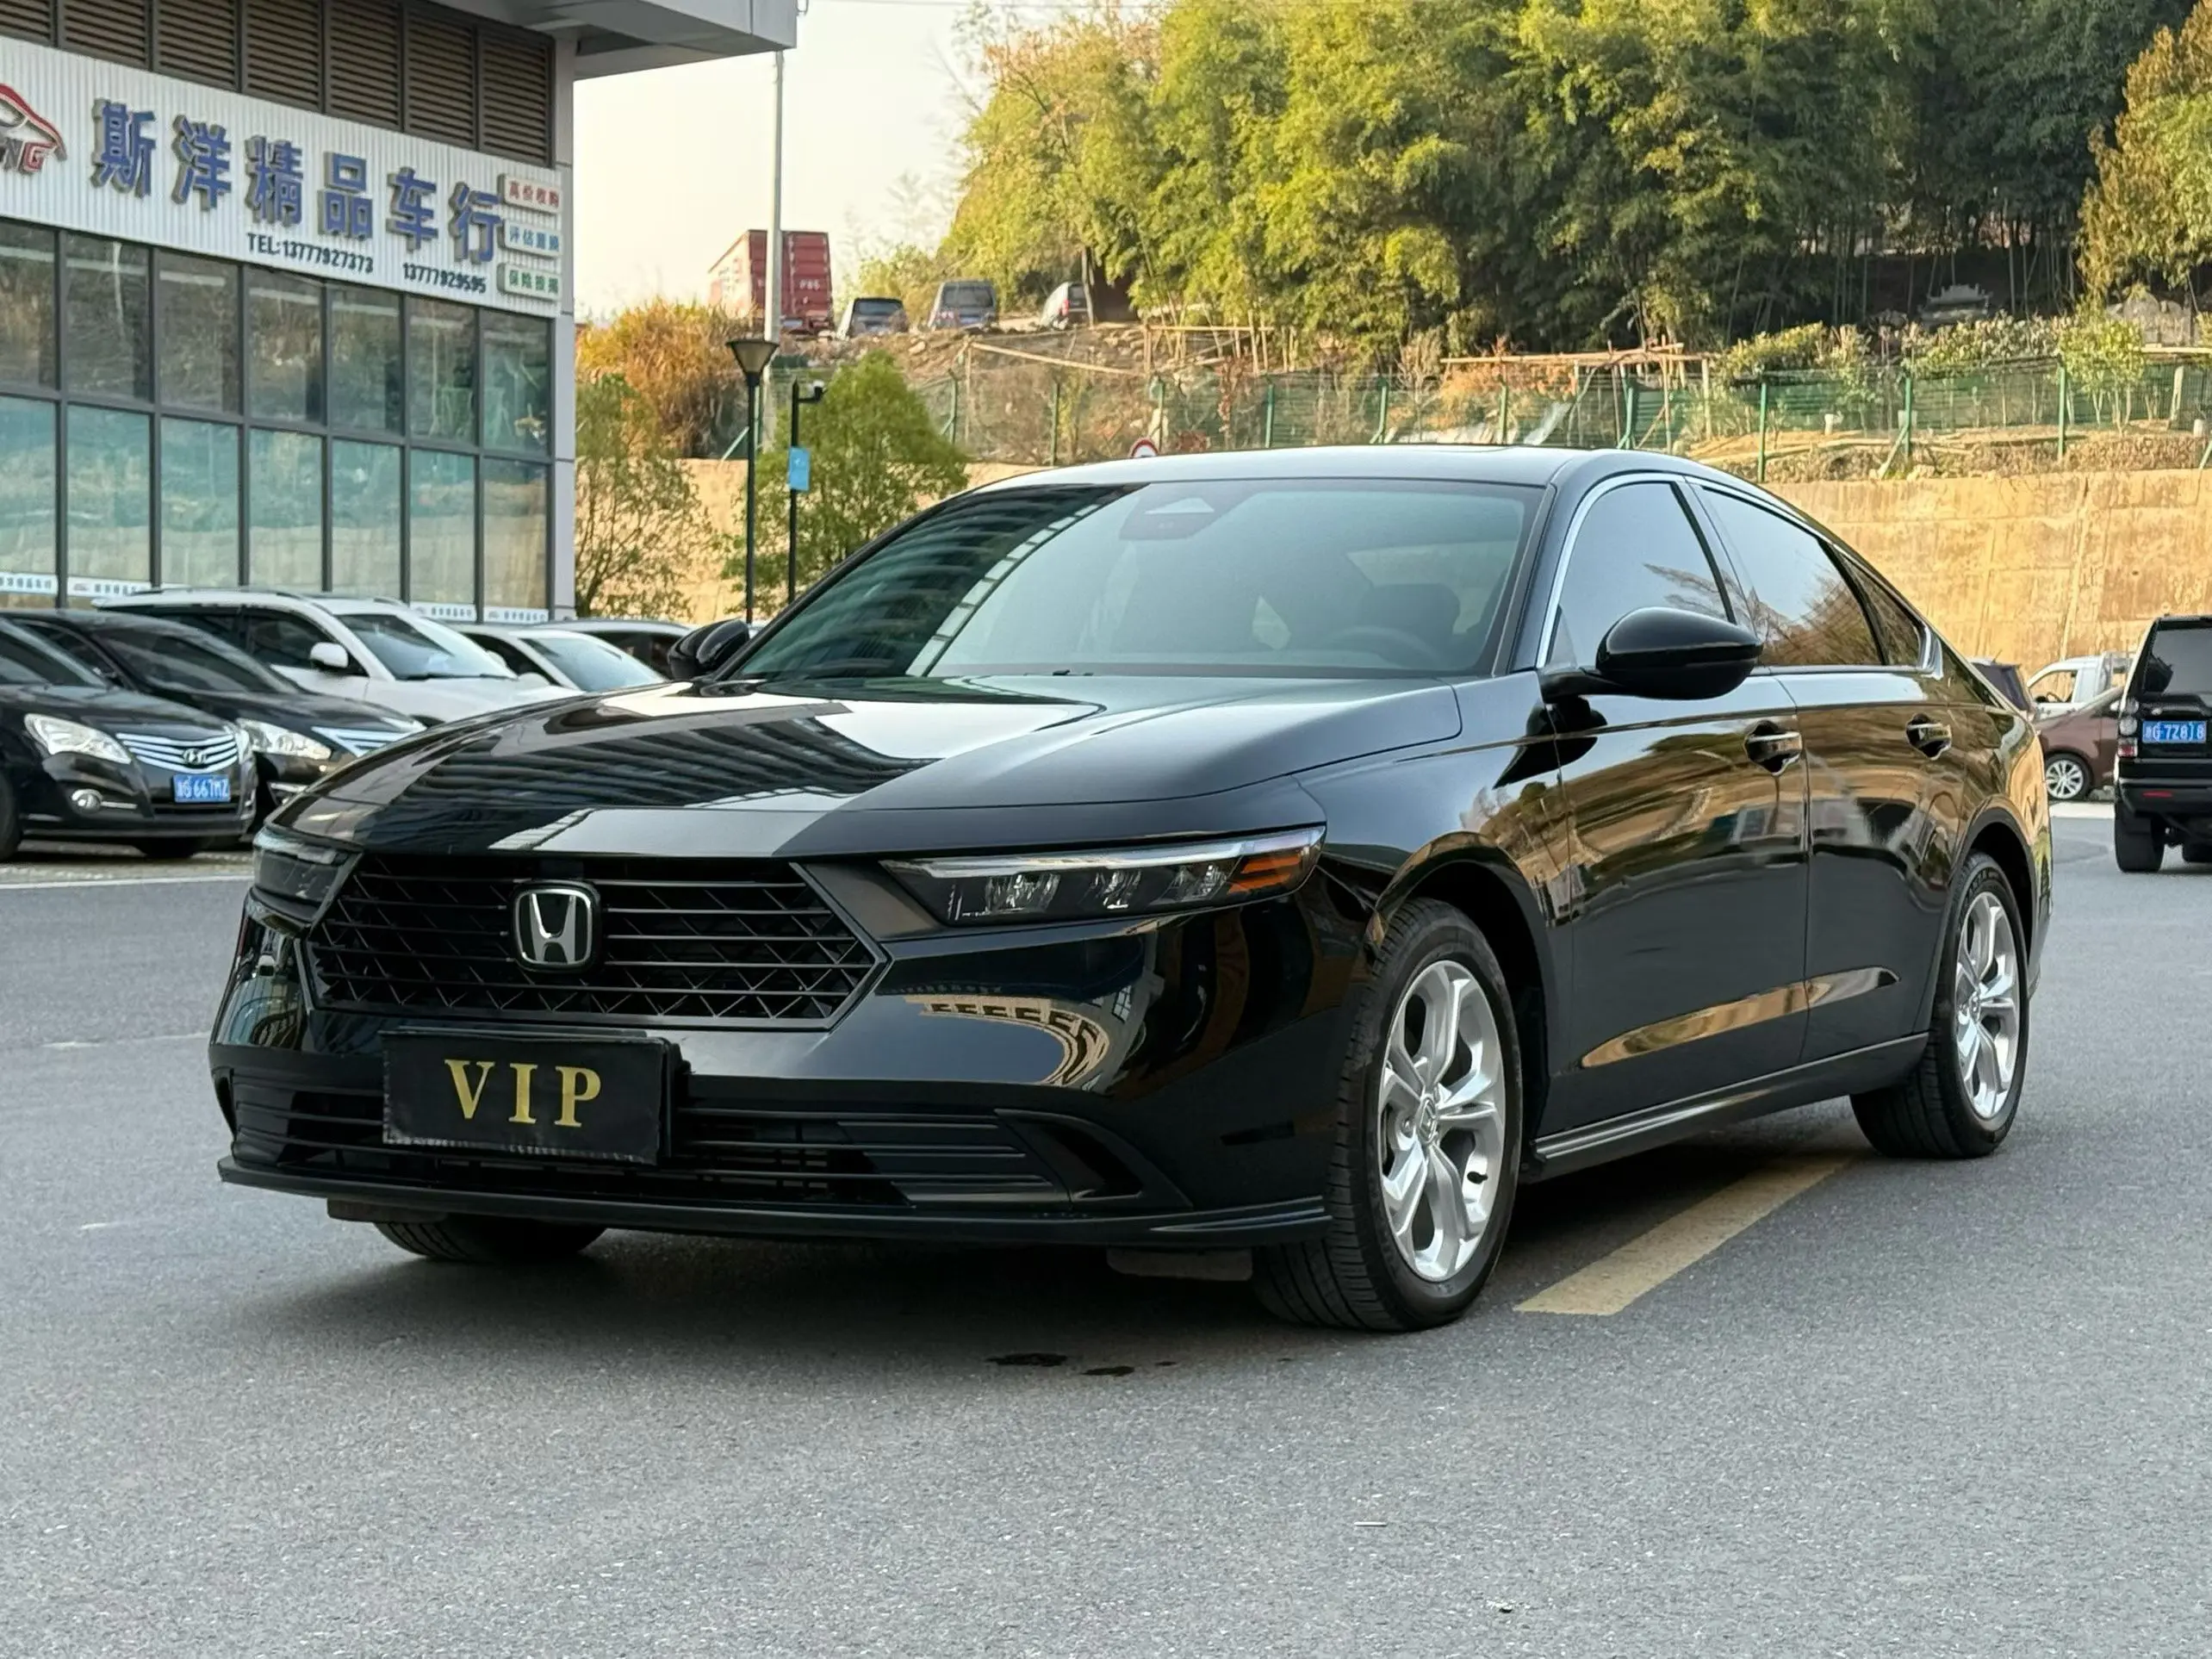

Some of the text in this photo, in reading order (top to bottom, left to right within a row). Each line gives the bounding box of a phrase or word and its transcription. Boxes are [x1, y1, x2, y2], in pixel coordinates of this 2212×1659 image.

[91, 98, 502, 265] 斯洋精品车行
[444, 1059, 602, 1128] VIP
